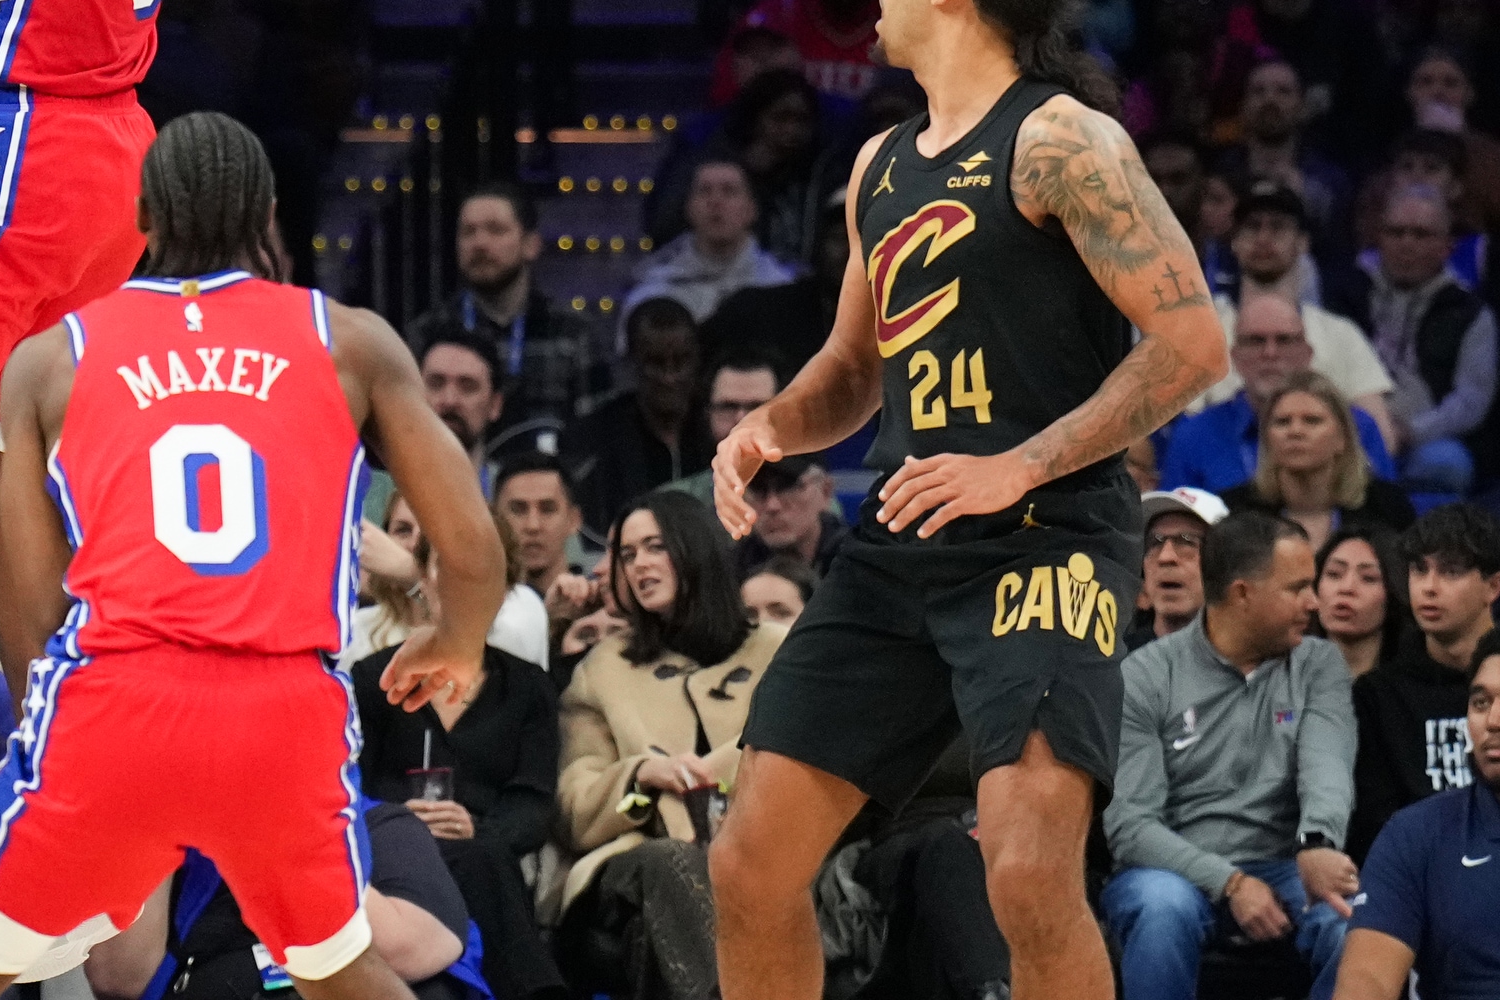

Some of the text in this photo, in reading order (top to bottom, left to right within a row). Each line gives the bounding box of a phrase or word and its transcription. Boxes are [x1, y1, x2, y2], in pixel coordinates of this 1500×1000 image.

[946, 174, 992, 189] CLIFFS
[117, 347, 290, 410] MAXEY
[908, 347, 993, 430] 24
[149, 424, 270, 577] 0
[991, 553, 1118, 658] CAVS
